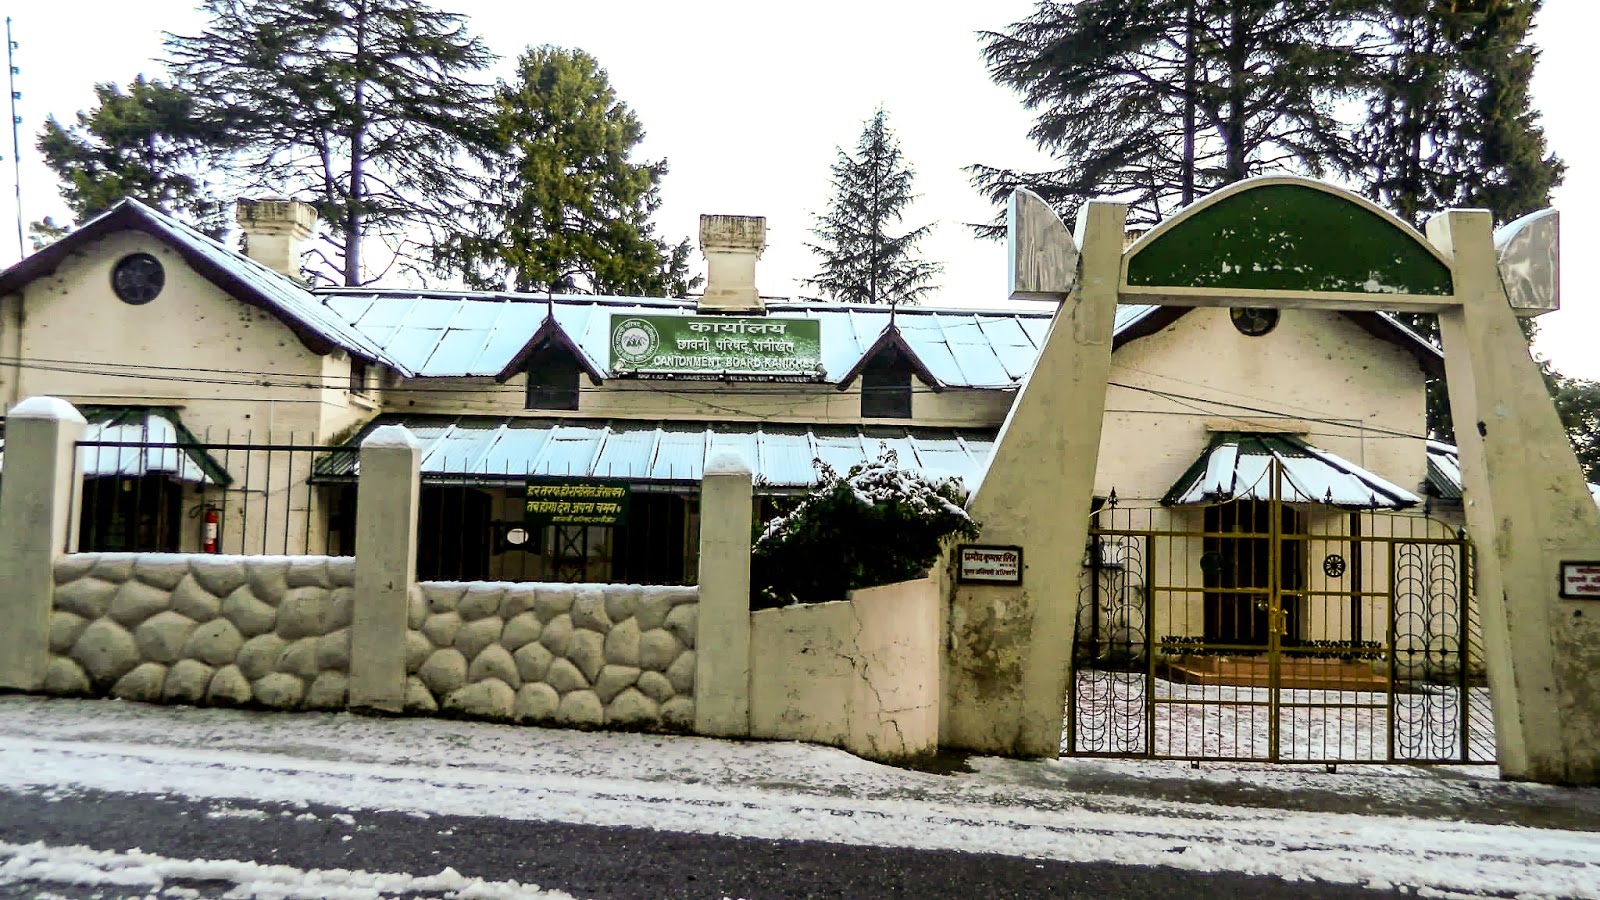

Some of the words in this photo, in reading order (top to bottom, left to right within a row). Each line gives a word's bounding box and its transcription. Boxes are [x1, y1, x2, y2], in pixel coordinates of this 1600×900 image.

[688, 319, 787, 335] कार्यालय
[676, 336, 710, 351] छावनी
[752, 337, 795, 354] रानीखेत
[654, 355, 721, 368] CANTONMENT
[726, 357, 761, 369] BOARD
